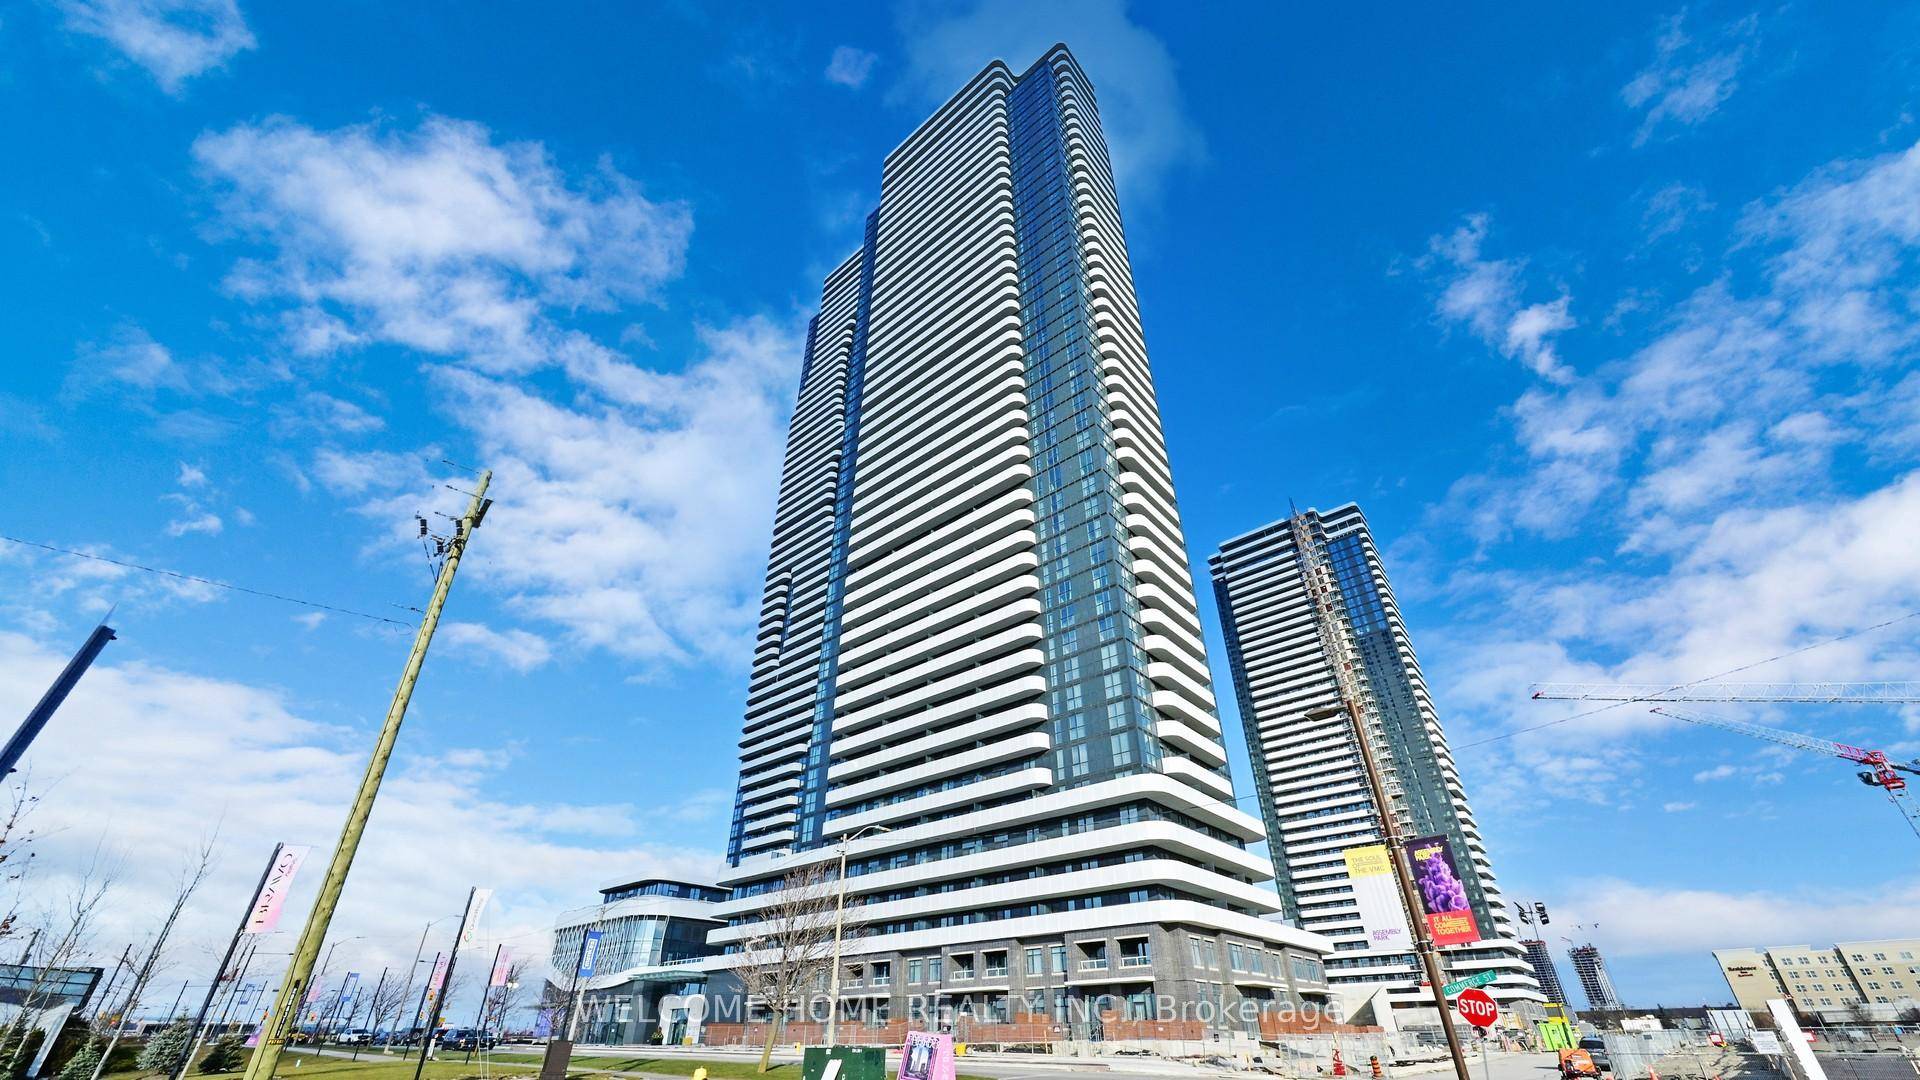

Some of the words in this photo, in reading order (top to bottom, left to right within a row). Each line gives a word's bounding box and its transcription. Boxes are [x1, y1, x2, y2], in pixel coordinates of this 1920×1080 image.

[1436, 926, 1472, 935] TOGETHER
[1446, 976, 1481, 994] COMMERCE
[1484, 972, 1493, 982] ST
[1460, 998, 1495, 1017] STOP
